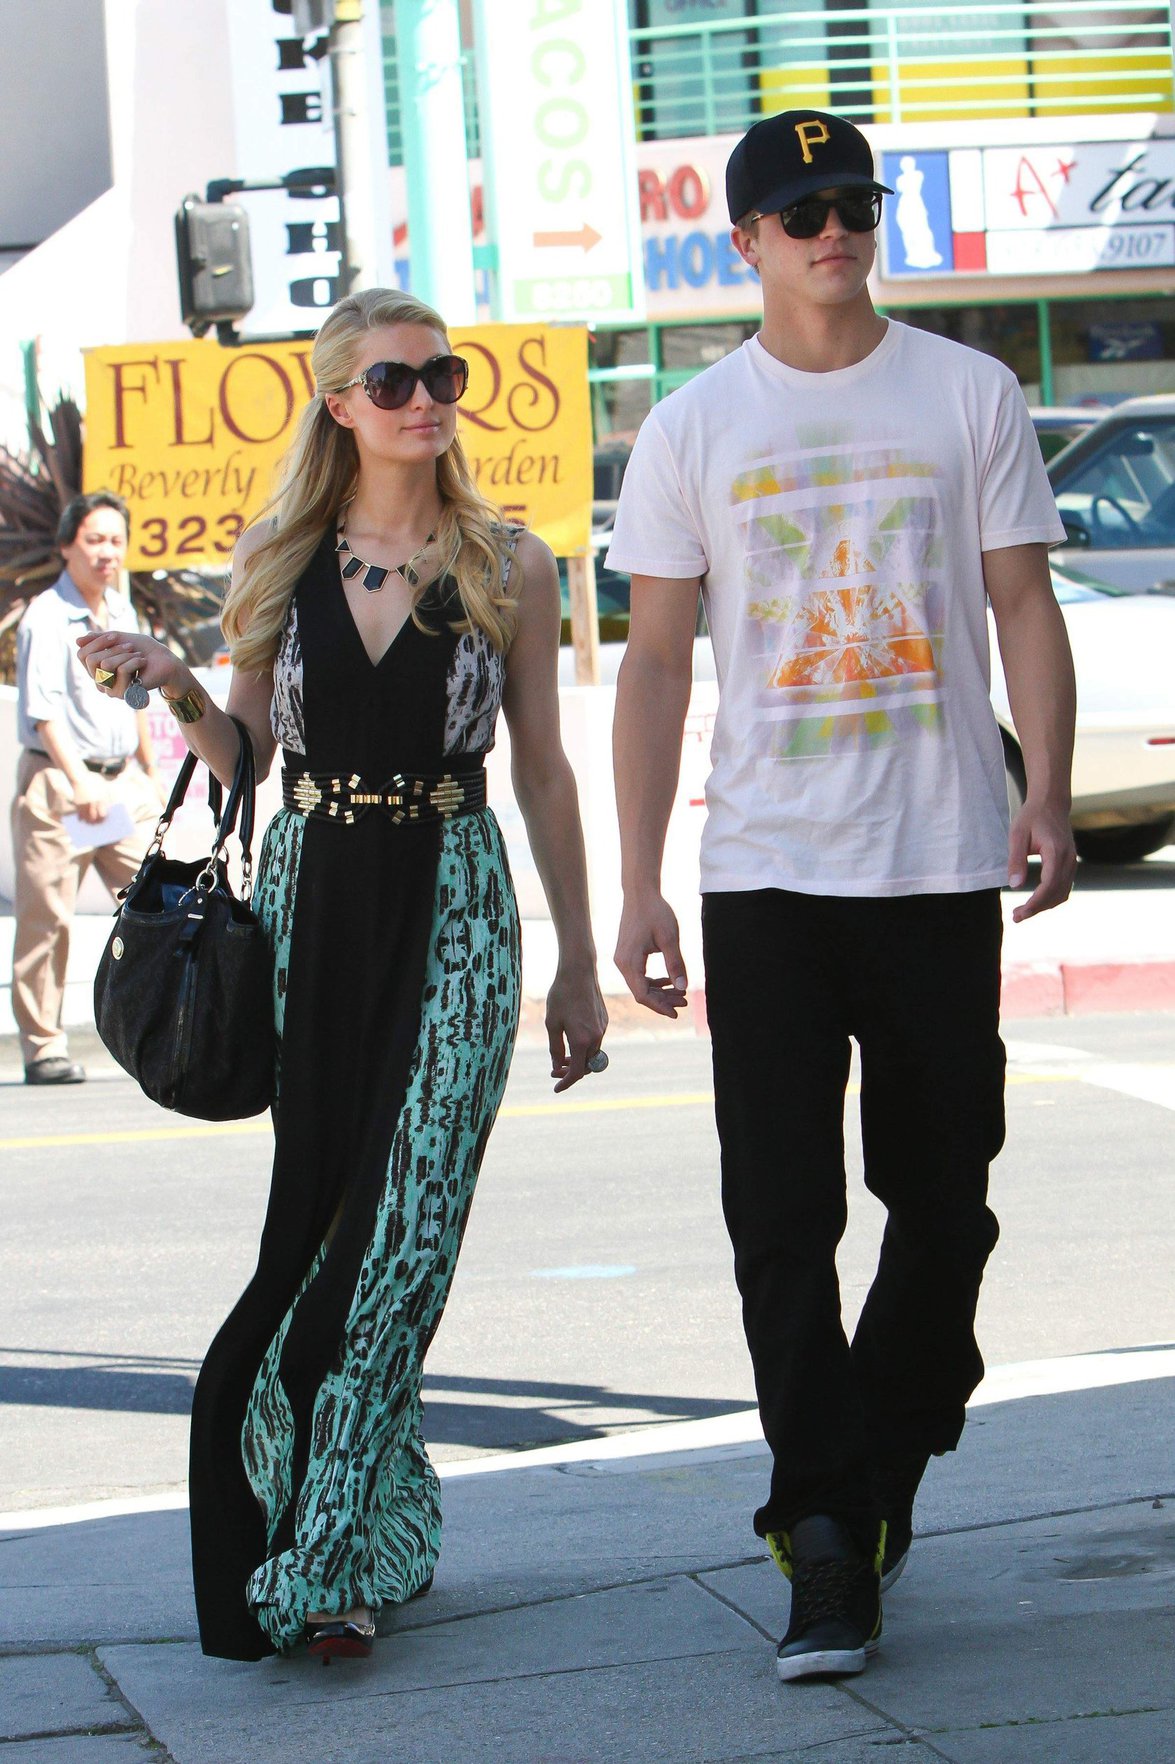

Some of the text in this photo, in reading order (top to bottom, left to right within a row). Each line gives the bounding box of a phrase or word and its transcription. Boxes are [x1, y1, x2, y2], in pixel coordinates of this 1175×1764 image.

[795, 120, 830, 164] P
[1090, 152, 1175, 213] ta
[645, 231, 761, 291] HOE
[109, 450, 257, 513] Beverly
[475, 439, 564, 486] rden
